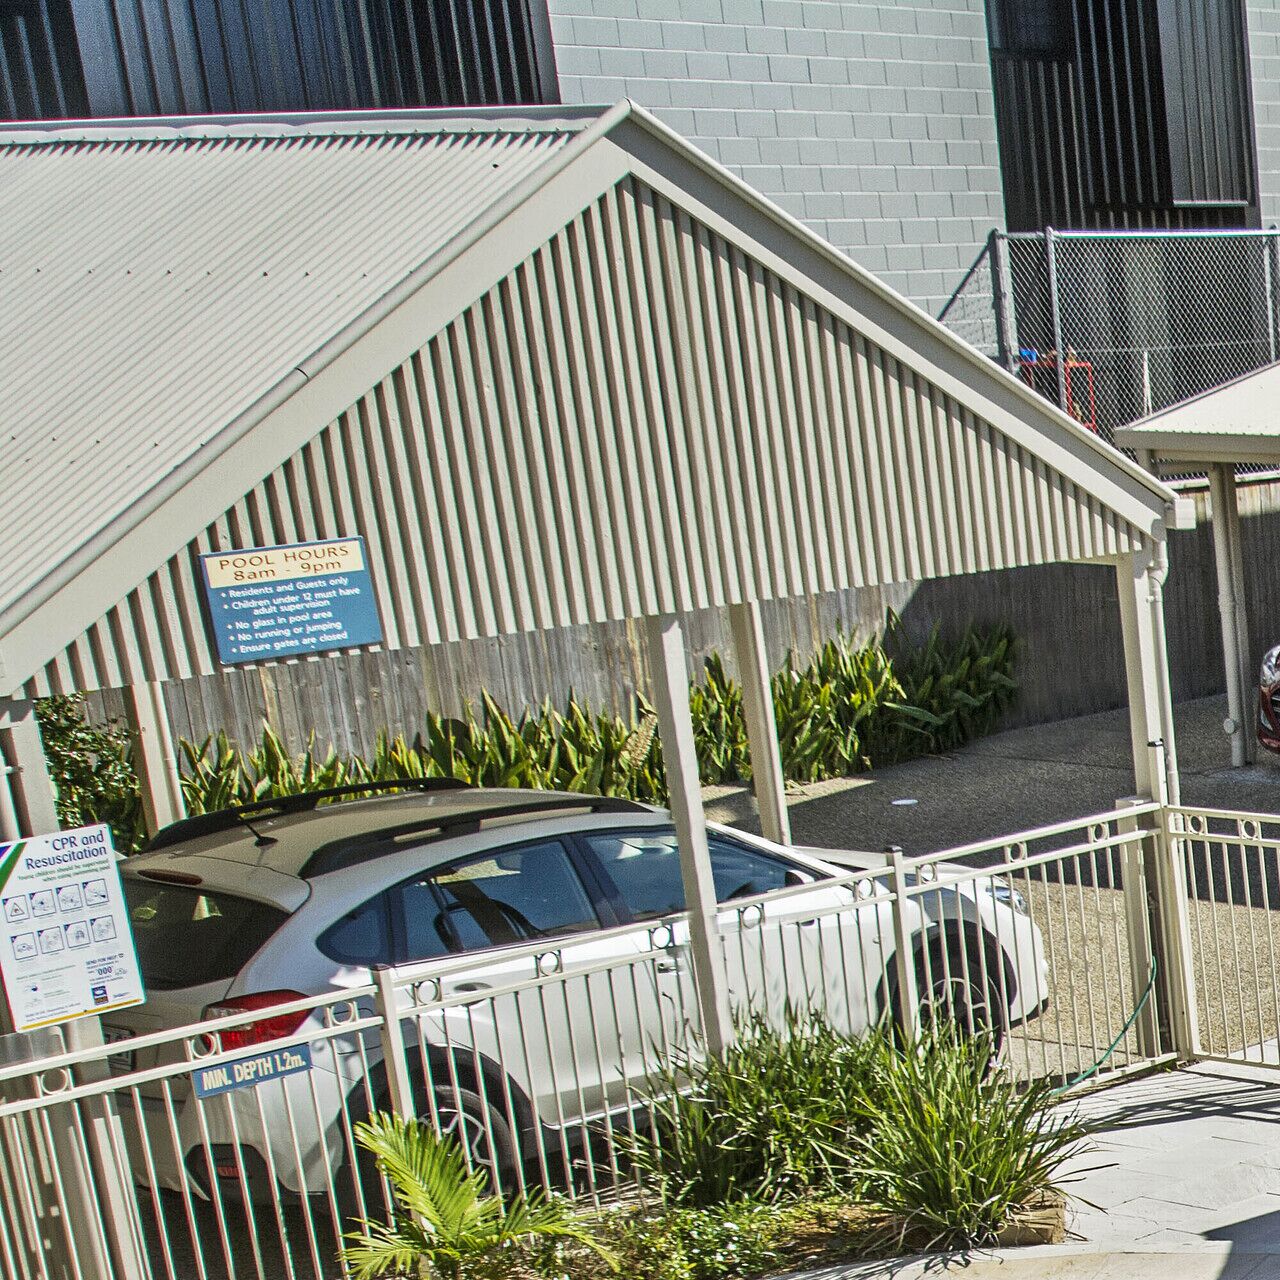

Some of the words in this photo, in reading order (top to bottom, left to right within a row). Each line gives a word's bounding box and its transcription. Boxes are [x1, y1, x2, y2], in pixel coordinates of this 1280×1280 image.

[219, 556, 275, 570] POOL
[284, 546, 349, 562] HOURS
[234, 568, 276, 581] 8am
[300, 560, 342, 574] 9pm
[228, 585, 273, 598] Residents
[276, 582, 294, 592] and
[296, 579, 327, 590] Guests
[329, 576, 349, 587] only
[231, 598, 270, 610] Children
[273, 595, 300, 605] under
[303, 592, 312, 601] 12
[315, 589, 337, 600] must
[339, 587, 361, 597] have
[253, 604, 278, 616] adult
[280, 599, 330, 614] supervision
[235, 620, 250, 630] No
[252, 617, 277, 630] glass
[278, 615, 287, 624] in
[289, 612, 310, 626] pool
[312, 610, 333, 619] area
[237, 633, 252, 642] No
[255, 627, 291, 640] running
[293, 626, 303, 635] or
[305, 620, 342, 635] jumping
[240, 642, 271, 654] Ensure
[274, 638, 299, 651] gates
[301, 637, 316, 645] are
[319, 631, 348, 643] closed
[52, 835, 79, 851] CPR
[81, 829, 105, 846] and
[25, 845, 108, 870] Resuscitation
[203, 1068, 232, 1090] MIN.
[234, 1058, 273, 1083] DEPTH
[274, 1052, 306, 1073] 1.2m.
